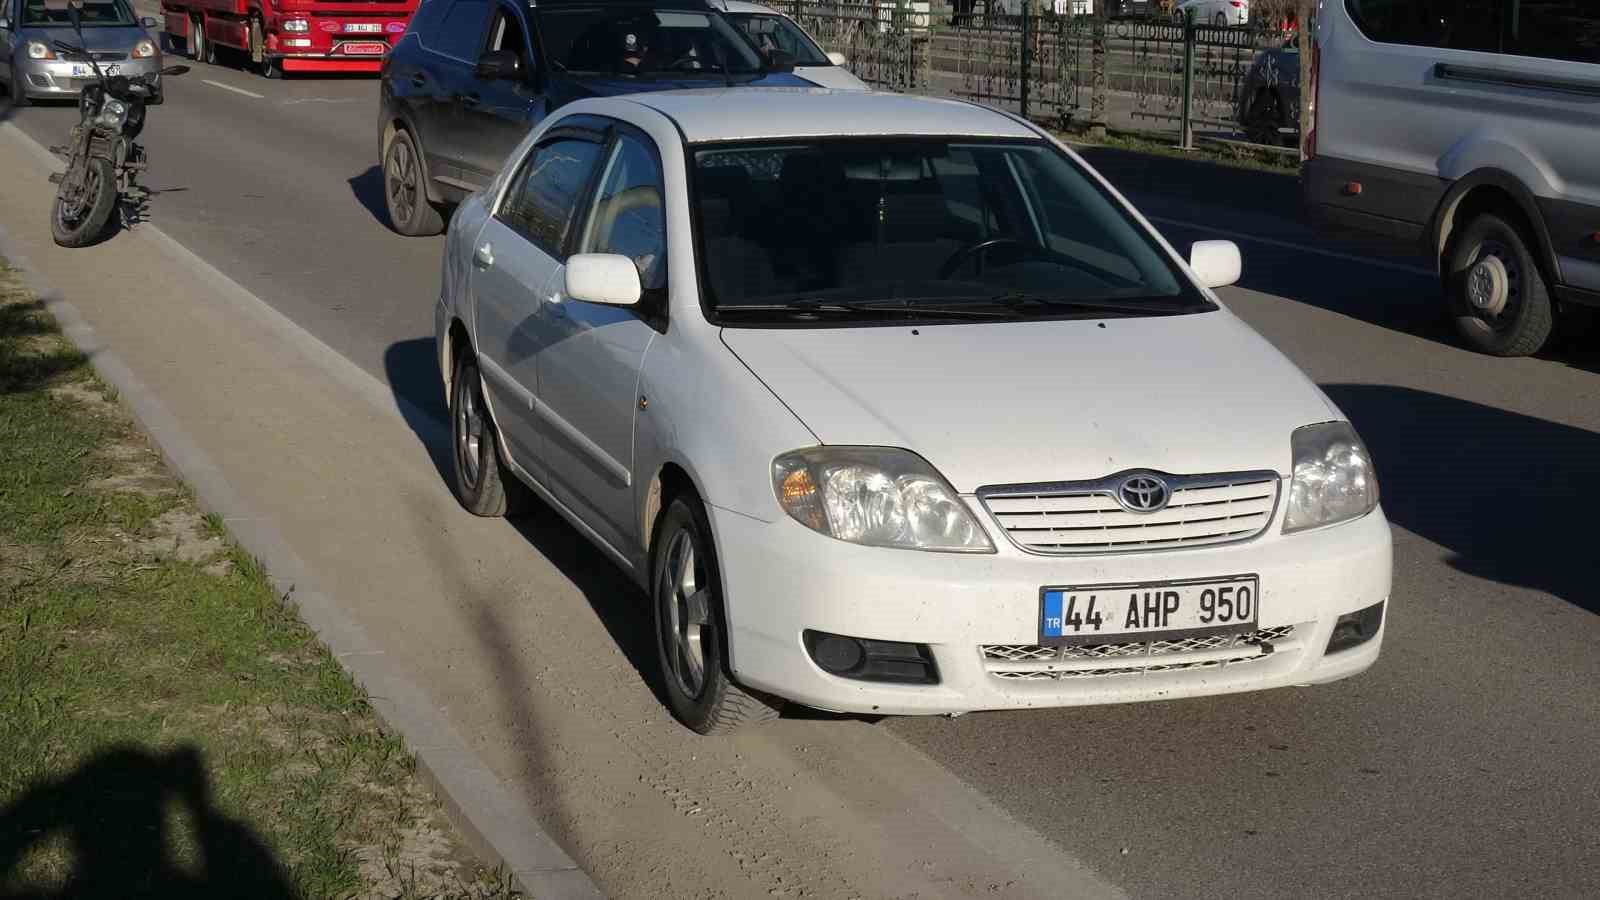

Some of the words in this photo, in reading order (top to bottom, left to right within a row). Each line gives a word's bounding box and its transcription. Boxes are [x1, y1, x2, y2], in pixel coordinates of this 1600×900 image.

[1065, 595, 1102, 631] 44
[1125, 591, 1180, 629] AHP
[1200, 585, 1250, 624] 950
[1047, 617, 1061, 629] TR
